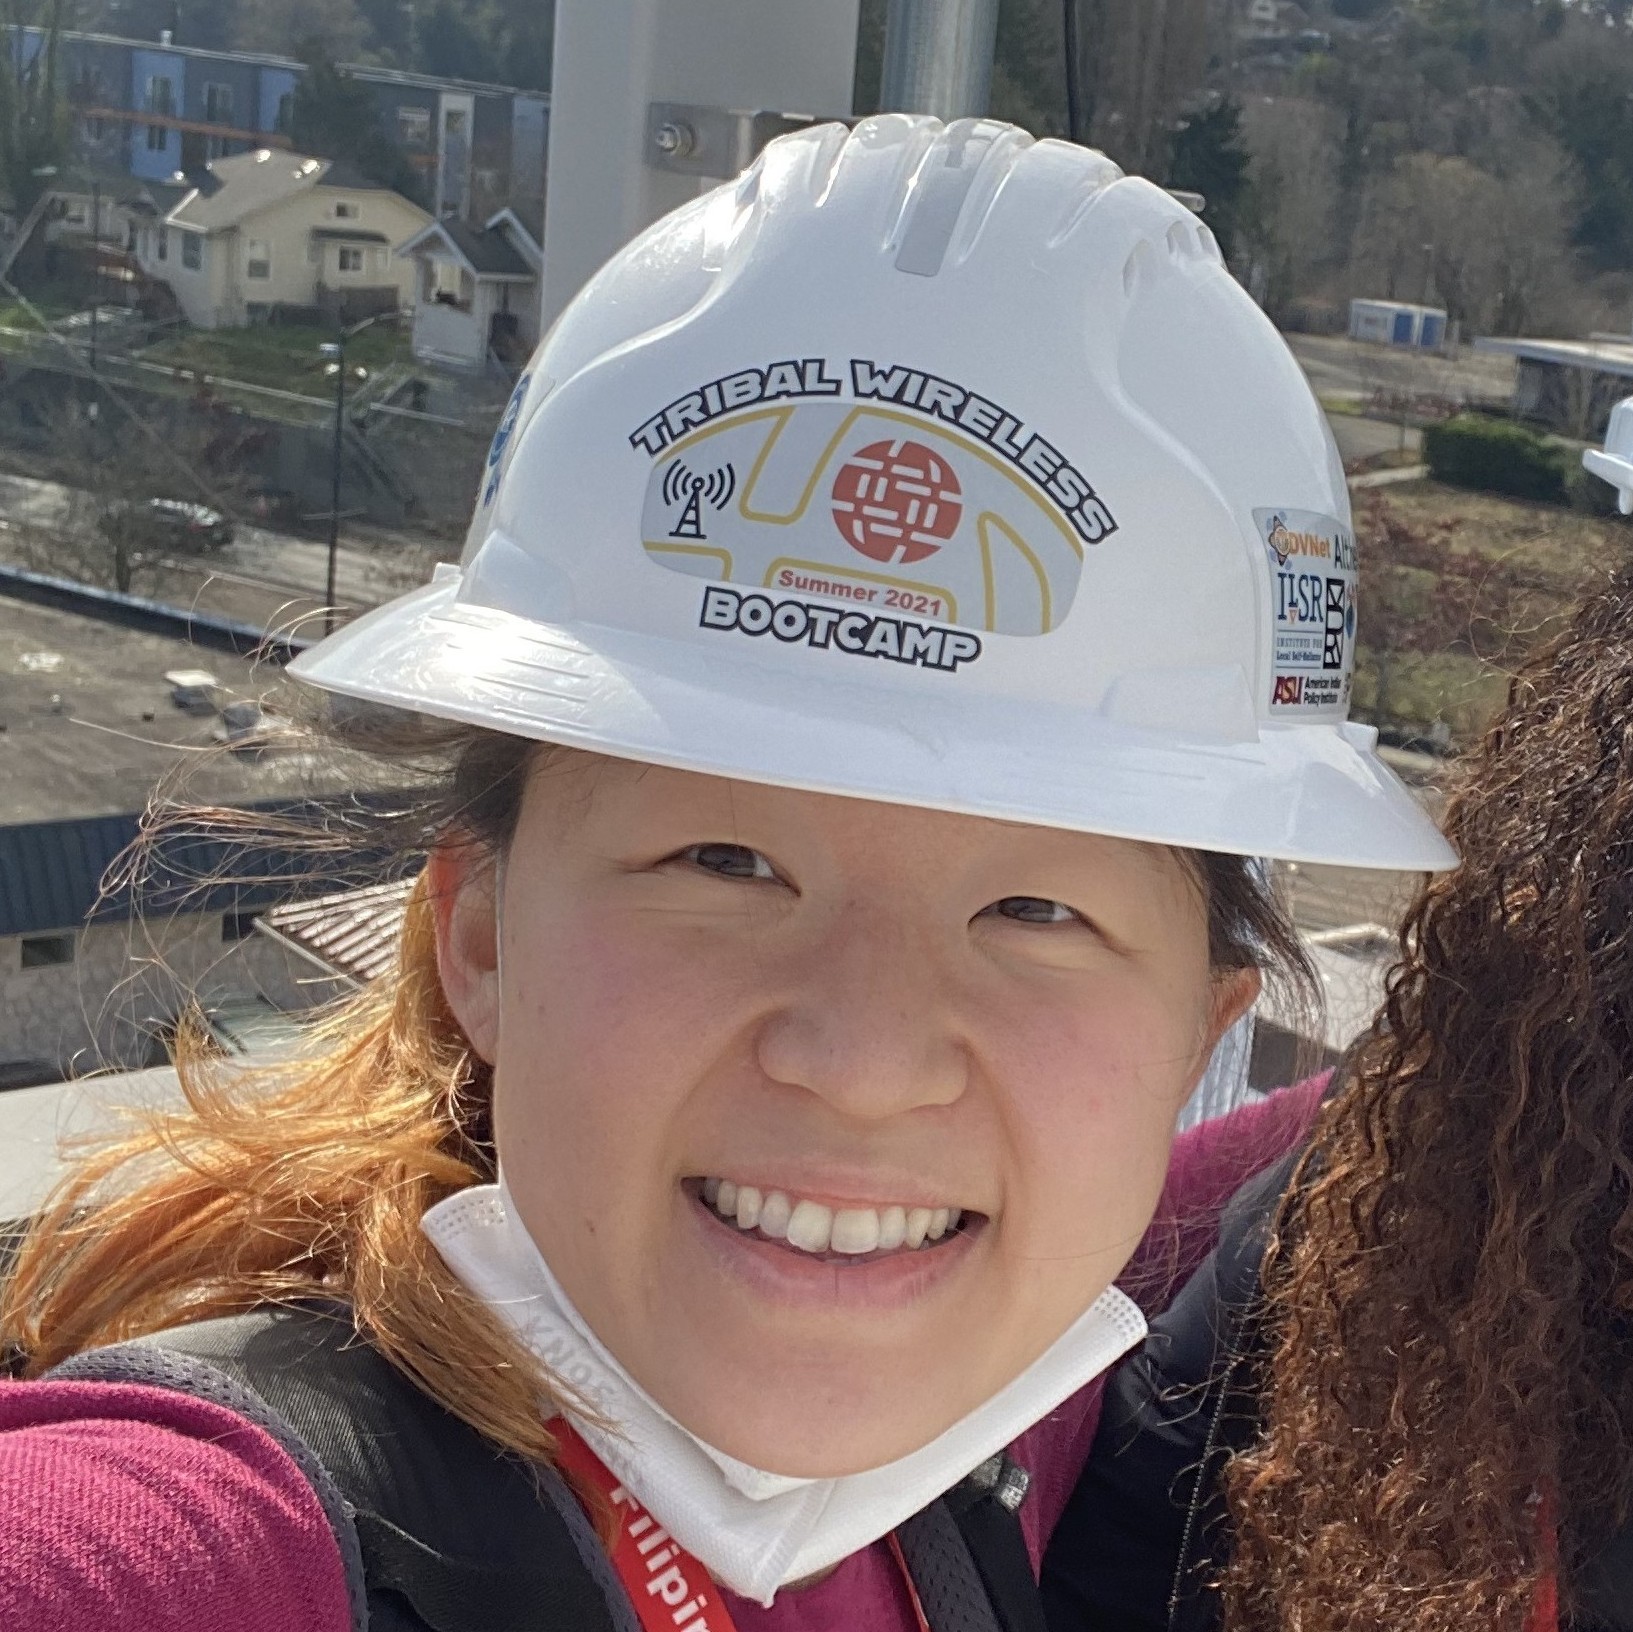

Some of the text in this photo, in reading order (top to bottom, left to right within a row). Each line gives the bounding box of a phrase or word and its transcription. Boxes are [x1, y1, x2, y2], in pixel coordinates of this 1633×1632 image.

[630, 358, 1120, 545] TRIBAL WIRELESS
[778, 568, 942, 617] Summer 2021
[1277, 572, 1324, 622] ILSR
[699, 585, 982, 673] BOOTCAMP
[1271, 675, 1304, 705] ASU
